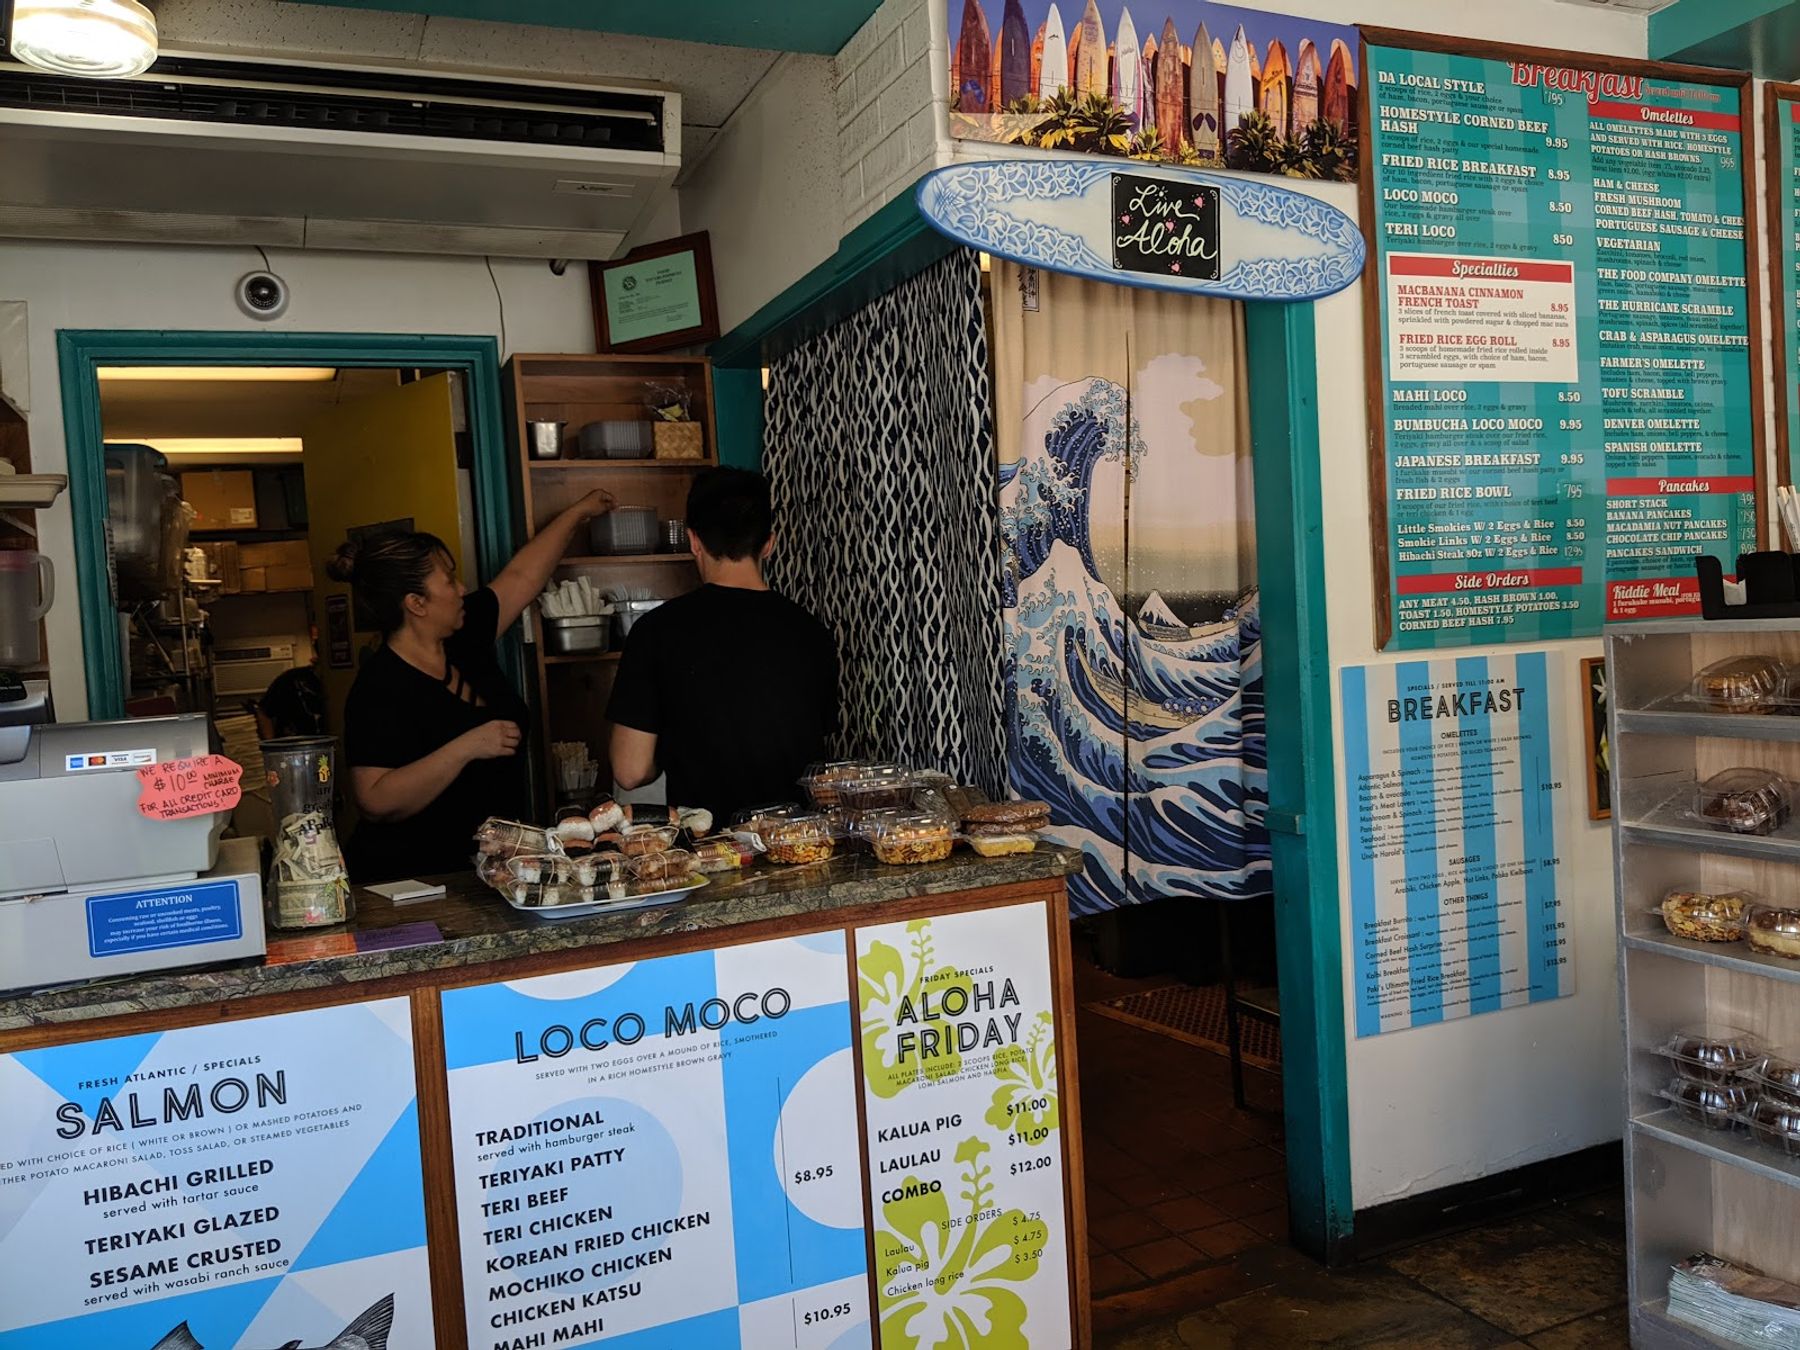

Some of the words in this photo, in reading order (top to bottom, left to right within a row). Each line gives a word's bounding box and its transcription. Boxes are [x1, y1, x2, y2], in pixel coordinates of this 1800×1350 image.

[1378, 71, 1395, 84] DA
[1399, 74, 1440, 89] LOCAL
[1444, 79, 1485, 94] STYLE
[1380, 106, 1460, 124] HOMESTYLE
[1464, 114, 1514, 129] CORNED
[1518, 120, 1548, 133] BEEF
[1640, 107, 1694, 125] Omelettes
[1381, 120, 1418, 134] HASH
[1546, 137, 1568, 149] 9.95
[1382, 155, 1423, 168] FRIED
[1427, 159, 1459, 171] RICE
[1462, 161, 1536, 178] BREAKFAST
[1548, 169, 1570, 181] 8.95
[1129, 184, 1200, 220] Live
[1383, 189, 1418, 202] LOCO
[1422, 192, 1459, 204] MOCO
[1549, 202, 1572, 213] 8.50
[1594, 192, 1626, 203] FRESH
[1628, 195, 1681, 209] MUSHROOM
[1117, 220, 1218, 259] Aloha
[1596, 219, 1657, 233] PORTUGUESE
[1660, 224, 1700, 236] SAUSAGE
[1702, 228, 1708, 237] &
[1711, 229, 1744, 240] CHEESE
[1597, 237, 1661, 251] VEGETARIAN
[1452, 260, 1519, 279] Specialties
[1397, 285, 1466, 297] MACBANANA
[1469, 289, 1524, 299] CINNAMON
[1398, 297, 1442, 308] FRENCH
[1446, 298, 1479, 309] TOAST
[1551, 303, 1568, 312] 8.95
[1399, 334, 1433, 344] FRIED
[1437, 335, 1462, 345] RICE
[1466, 336, 1487, 346] EGG
[1491, 336, 1517, 346] ROLL
[1552, 338, 1570, 347] 8.95
[1394, 419, 1468, 431] BUMBUCHA
[1472, 419, 1504, 430] LOCO
[1508, 419, 1543, 430] MOCO
[1559, 420, 1581, 430] 9.95
[1605, 442, 1647, 453] SPANISH
[1651, 442, 1702, 452] OMELETTE
[1395, 456, 1461, 468] JAPANESE
[1465, 454, 1540, 465] BREAKFAST
[1561, 454, 1584, 464] 9.95
[1658, 479, 1710, 493] Pancakes
[1398, 524, 1425, 534] Little
[1428, 523, 1471, 533] Smokies
[1488, 523, 1494, 531] 2
[1498, 521, 1520, 531] Eggs
[1523, 520, 1531, 529] &
[1534, 520, 1554, 529] Rice
[1566, 519, 1584, 528] 8.50
[1606, 533, 1659, 544] CHOCOLATE
[1661, 532, 1681, 541] CHIP
[1684, 531, 1728, 540] PANCAKES
[1455, 575, 1482, 590] Side
[1486, 573, 1529, 587] Orders
[1613, 586, 1650, 599] Kiddie
[1653, 583, 1680, 596] Meal
[1388, 688, 1525, 723] BREAKFAST
[1441, 729, 1478, 740] OMELETTES
[1358, 771, 1389, 782] Asparagus
[1398, 767, 1421, 778] Spinach
[140, 803, 158, 813] FOR
[163, 798, 177, 808] ALL
[180, 791, 212, 805] CREDIT
[215, 787, 238, 798] CARD
[1449, 855, 1481, 865] SAUSAGES
[136, 895, 193, 909] ATTENTION
[1443, 895, 1464, 906] OTHER
[1466, 893, 1489, 903] THINGS
[920, 973, 951, 984] FRIDAY
[954, 966, 994, 978] SPECIALS
[896, 978, 1020, 1027] ALOHA
[515, 1013, 647, 1064] LOCO
[664, 987, 792, 1039] MOCO
[897, 1012, 1022, 1064] FRIDAY
[535, 1068, 565, 1081] SERVED
[568, 1064, 588, 1075] WITH
[591, 1061, 609, 1071] TWO
[612, 1056, 634, 1068] EGGS
[637, 1051, 657, 1063] OVER
[660, 1050, 665, 1058] A
[668, 1044, 698, 1057] MOUND
[700, 1042, 711, 1051] OF
[713, 1039, 732, 1049] RICE,
[734, 1030, 778, 1045] SMOTHERED
[78, 1076, 119, 1091] FRESH
[124, 1067, 187, 1083] ATLANTIC
[204, 1055, 262, 1072] SPECIALS
[918, 1079, 934, 1090] LOMI
[935, 1075, 966, 1086] SALMON
[967, 1071, 982, 1082] AND
[983, 1066, 1008, 1078] HAUPIA
[55, 1070, 287, 1140] SALMON
[475, 1111, 605, 1148] TRADITIONAL
[878, 1120, 931, 1143] KALUA
[935, 1114, 962, 1131] PIG
[1006, 1097, 1048, 1117] $11.00
[880, 1149, 941, 1174] LAULAU
[1008, 1127, 1049, 1146] $11.00
[479, 1161, 564, 1191] TERIYAKI
[571, 1147, 626, 1172] PATTY
[794, 1165, 834, 1185] $8.95
[882, 1180, 942, 1204] COMBO
[1010, 1156, 1052, 1176] $12.00
[83, 1175, 178, 1206] HIBACHI
[186, 1159, 274, 1188] GRILLED
[103, 1200, 147, 1219] served
[151, 1196, 178, 1209] with
[182, 1188, 219, 1204] tartar
[223, 1183, 259, 1197] sauce
[85, 1223, 186, 1255] TERIYAKI
[193, 1206, 279, 1234] GLAZED
[941, 1217, 963, 1230] SIDE
[966, 1208, 1003, 1225] ORDERS
[486, 1244, 568, 1274] KOREAN
[575, 1231, 625, 1257] FRIED
[631, 1211, 711, 1241] CHICKEN
[885, 1243, 915, 1257] Laulau
[89, 1258, 179, 1289] SESAME
[186, 1239, 281, 1270] CRUSTED
[488, 1268, 584, 1301] MOCHIKO
[591, 1248, 673, 1277] CHICKEN
[886, 1264, 913, 1277] Kalua
[915, 1260, 930, 1271] pig
[887, 1280, 923, 1297] Chicken
[925, 1275, 945, 1289] long
[948, 1270, 964, 1282] rice
[1023, 1249, 1043, 1261] 3.50
[85, 1288, 129, 1306] served
[133, 1282, 160, 1297] with
[165, 1272, 210, 1292] wasabi
[215, 1265, 250, 1281] ranch
[255, 1258, 289, 1273] sauce
[491, 1300, 576, 1330] CHICKEN
[583, 1282, 642, 1308] KATSU
[804, 1303, 851, 1326] $10.95
